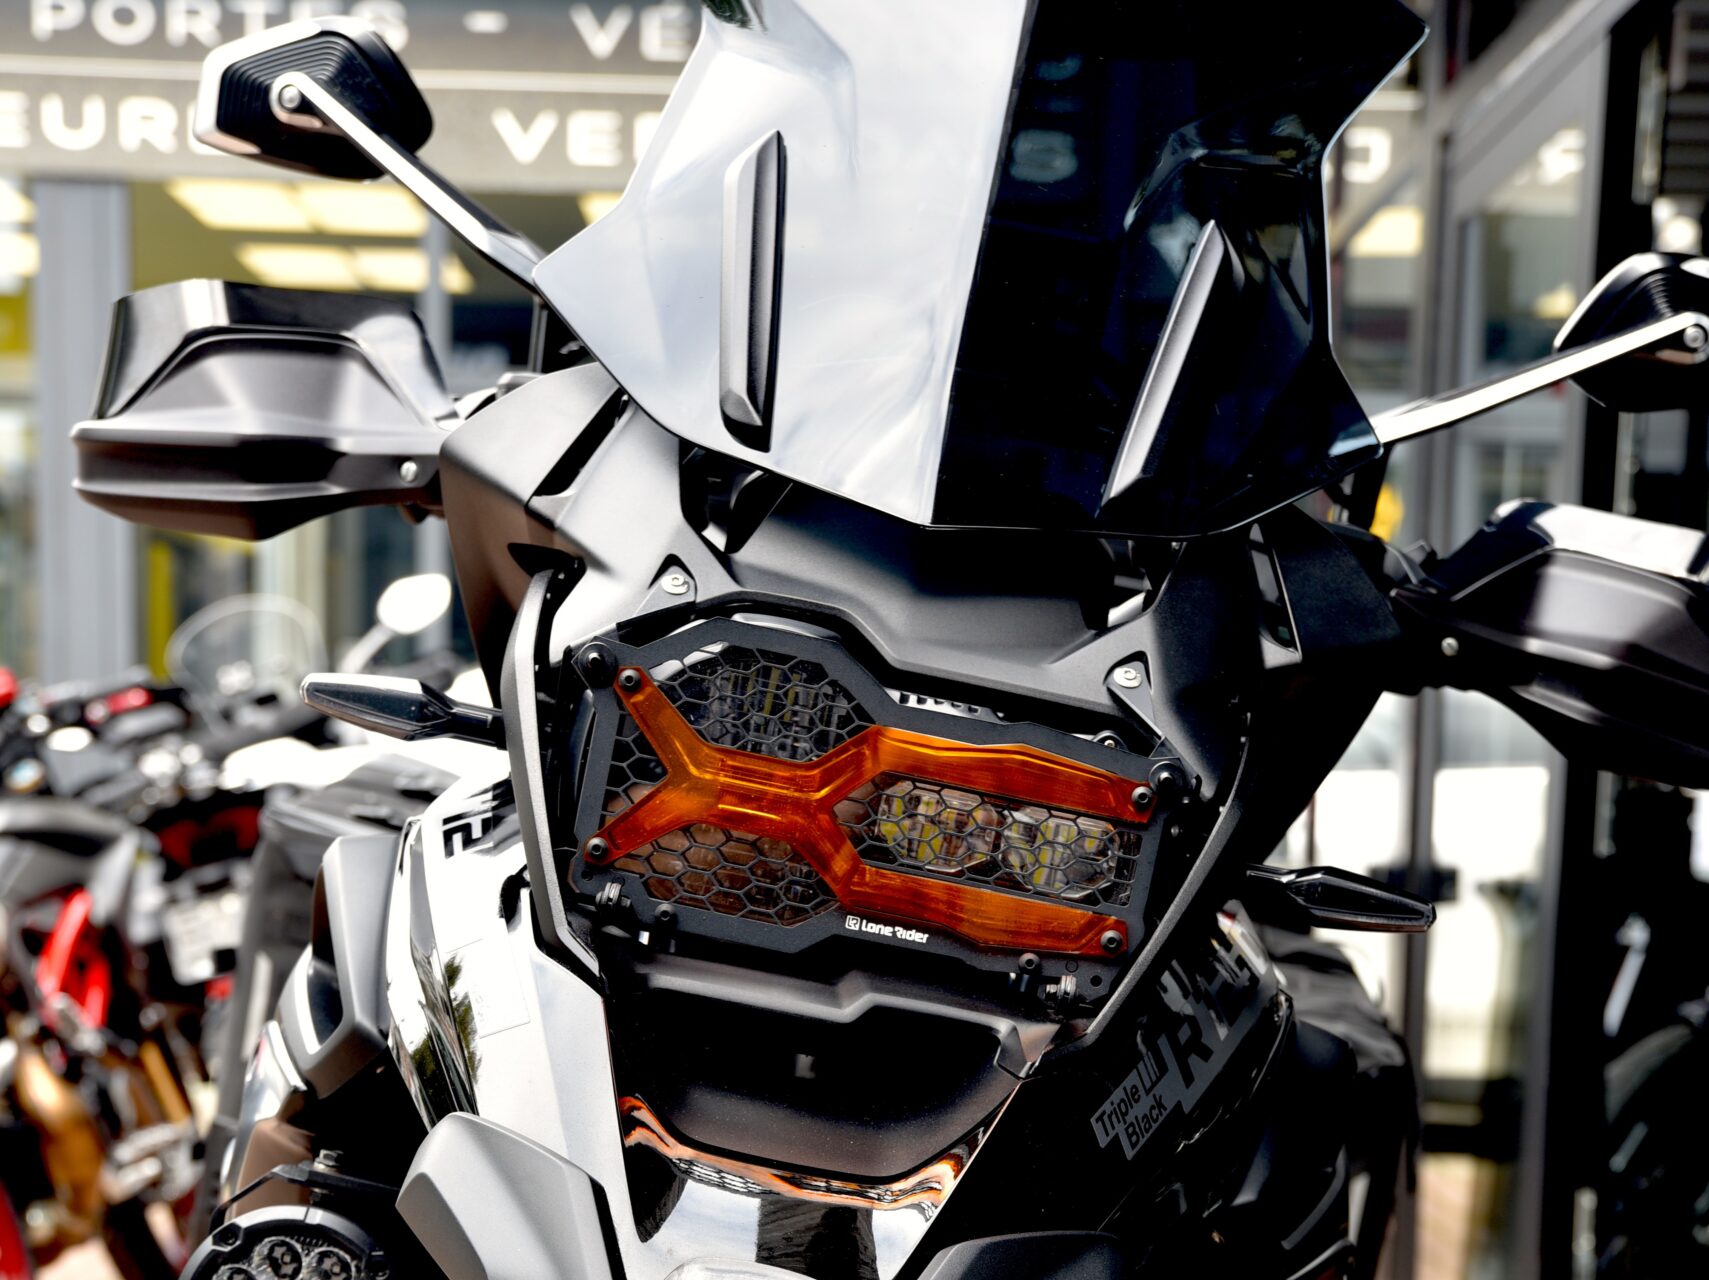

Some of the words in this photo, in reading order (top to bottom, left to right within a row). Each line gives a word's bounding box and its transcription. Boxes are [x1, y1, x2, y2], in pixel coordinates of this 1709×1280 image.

[30, 0, 409, 52] PORTS
[894, 926, 929, 943] Rider
[1095, 1083, 1141, 1137] Triple
[1124, 1091, 1168, 1152] Black
